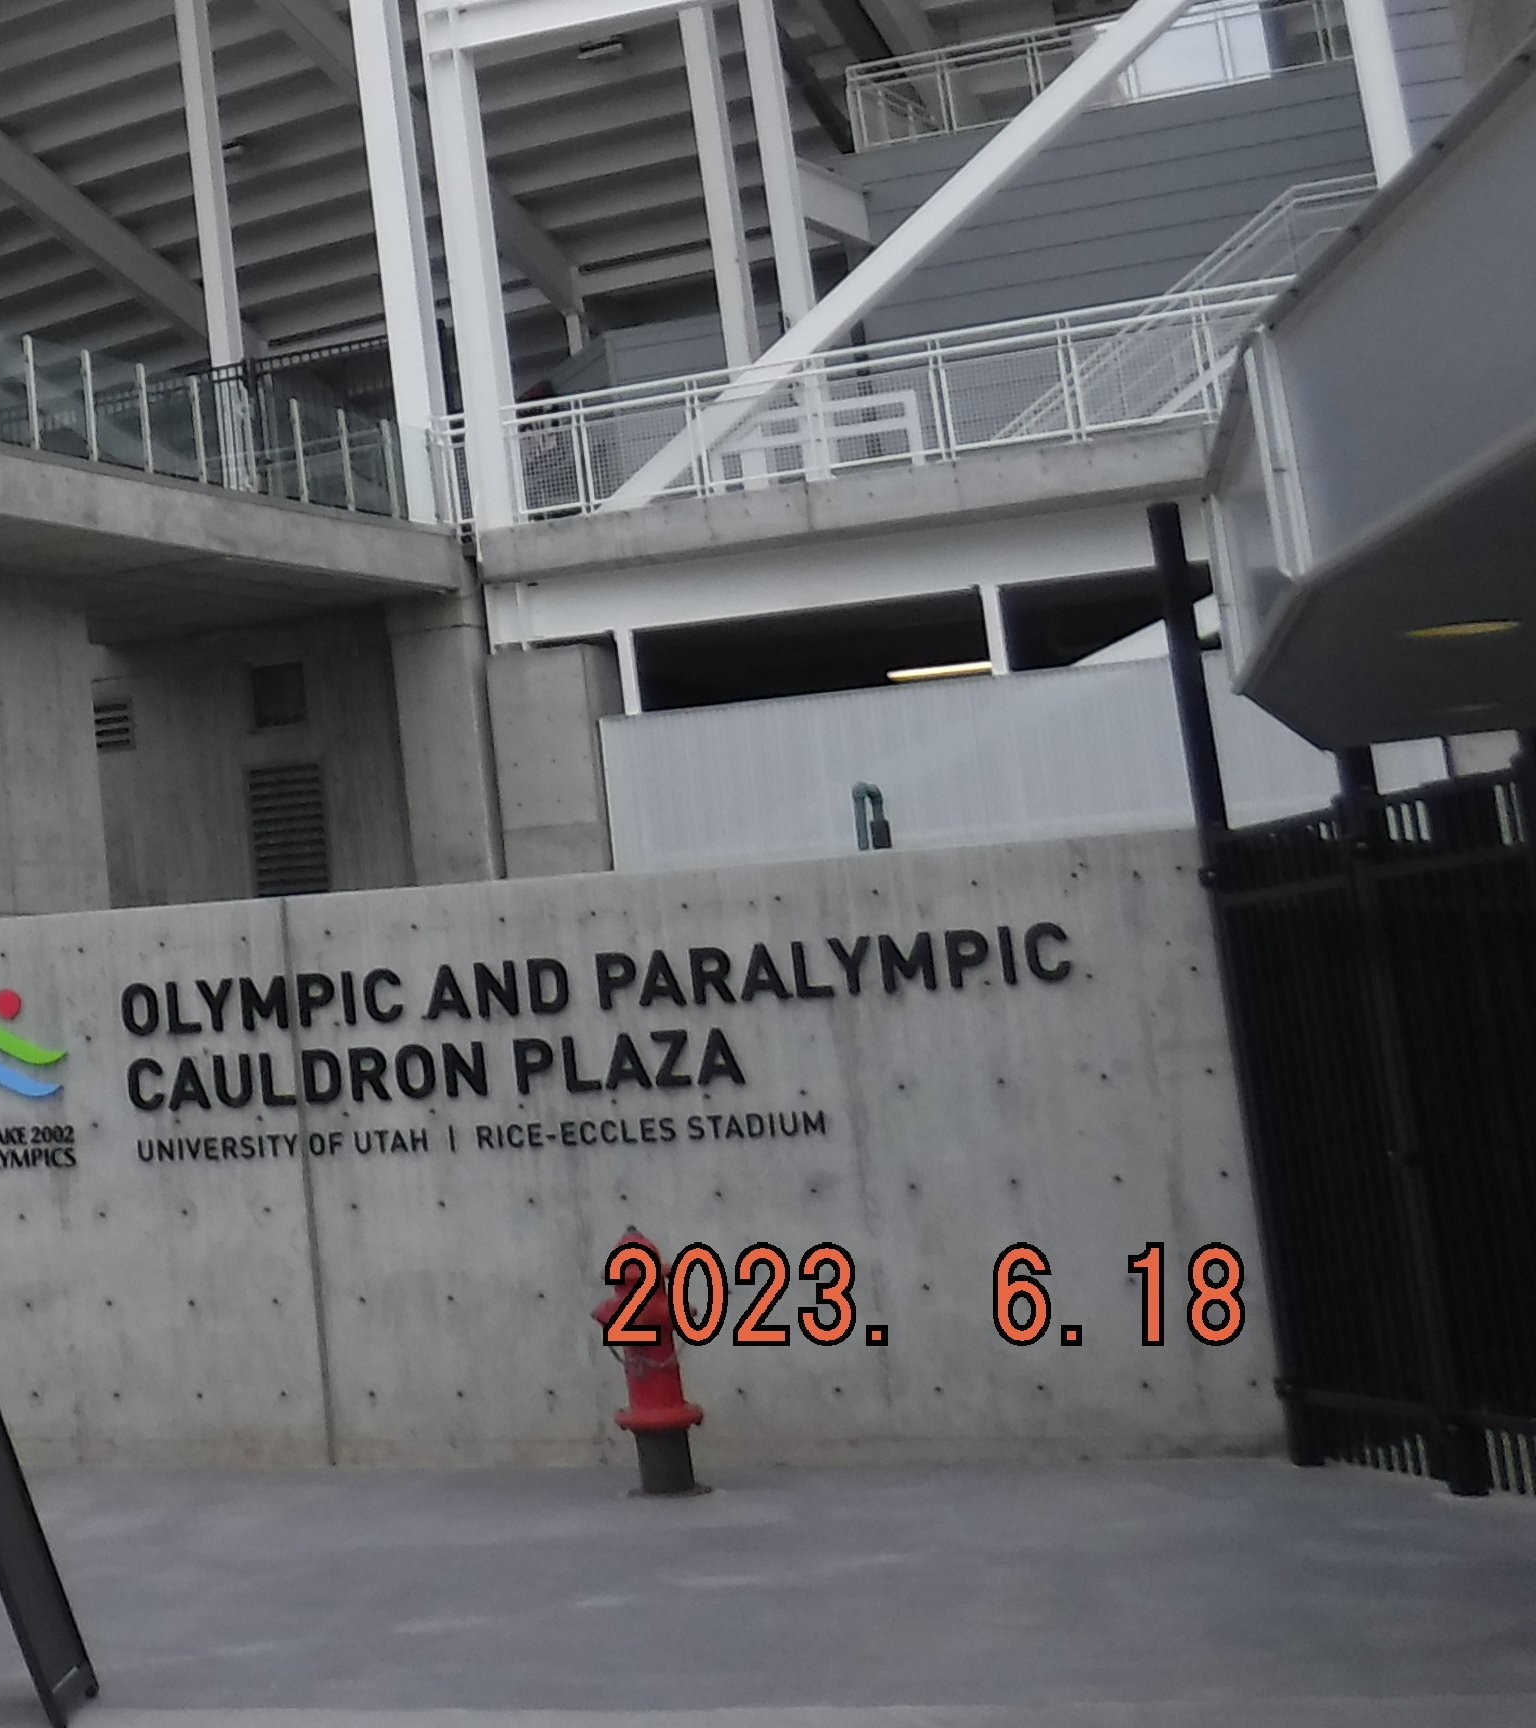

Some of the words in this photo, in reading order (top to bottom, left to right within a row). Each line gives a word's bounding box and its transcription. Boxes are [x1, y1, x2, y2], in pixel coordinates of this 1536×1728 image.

[121, 968, 403, 1037] OLYMPIC
[423, 955, 571, 1021] AND
[596, 920, 1073, 1012] PARALYMPIC
[127, 1041, 491, 1112] CAULDRON
[515, 1027, 747, 1096] PLAZA
[30, 1124, 76, 1145] 2002
[137, 1132, 297, 1163] UNIVERSITY
[308, 1131, 342, 1158] OF
[355, 1127, 430, 1156] UTAH
[475, 1116, 677, 1150] RICE-ECCLES
[686, 1110, 827, 1143] STADIUM
